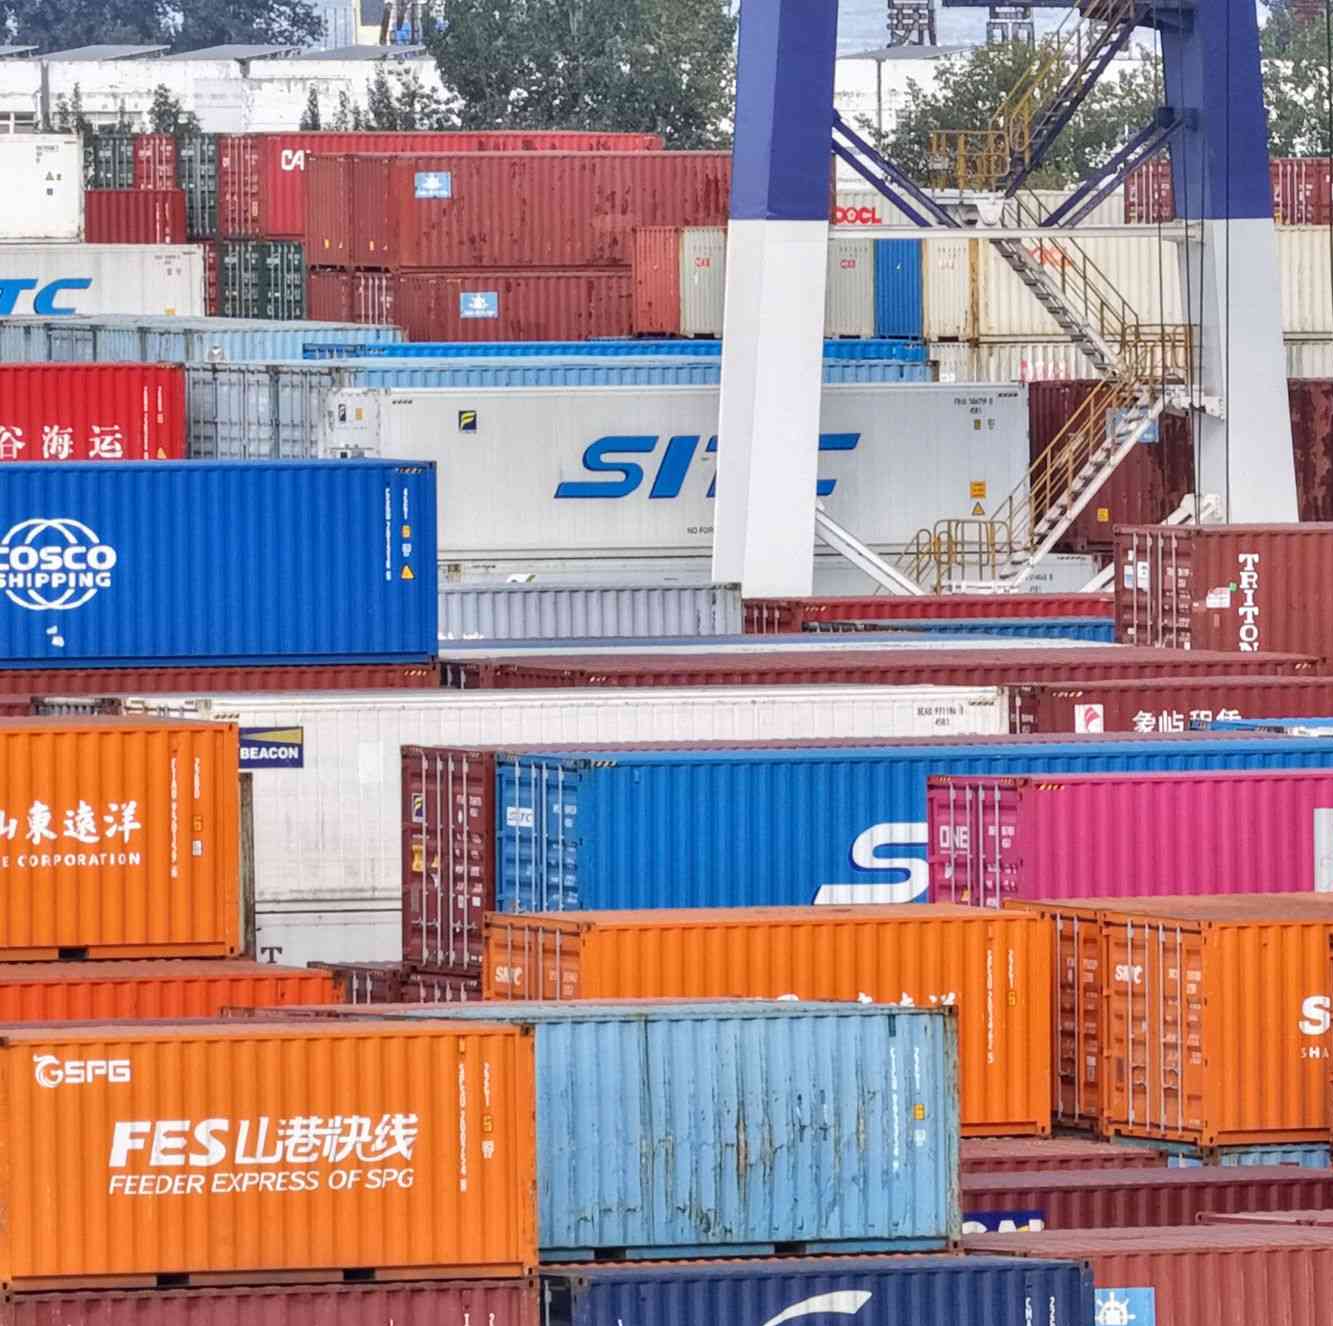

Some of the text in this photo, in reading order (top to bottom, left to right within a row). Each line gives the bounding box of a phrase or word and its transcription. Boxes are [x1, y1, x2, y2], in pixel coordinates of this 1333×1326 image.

[240, 746, 299, 759] BEACON
[17, 852, 141, 868] CORPORATION
[109, 1168, 415, 1196] FEEDER EXPRESS OF SPG
